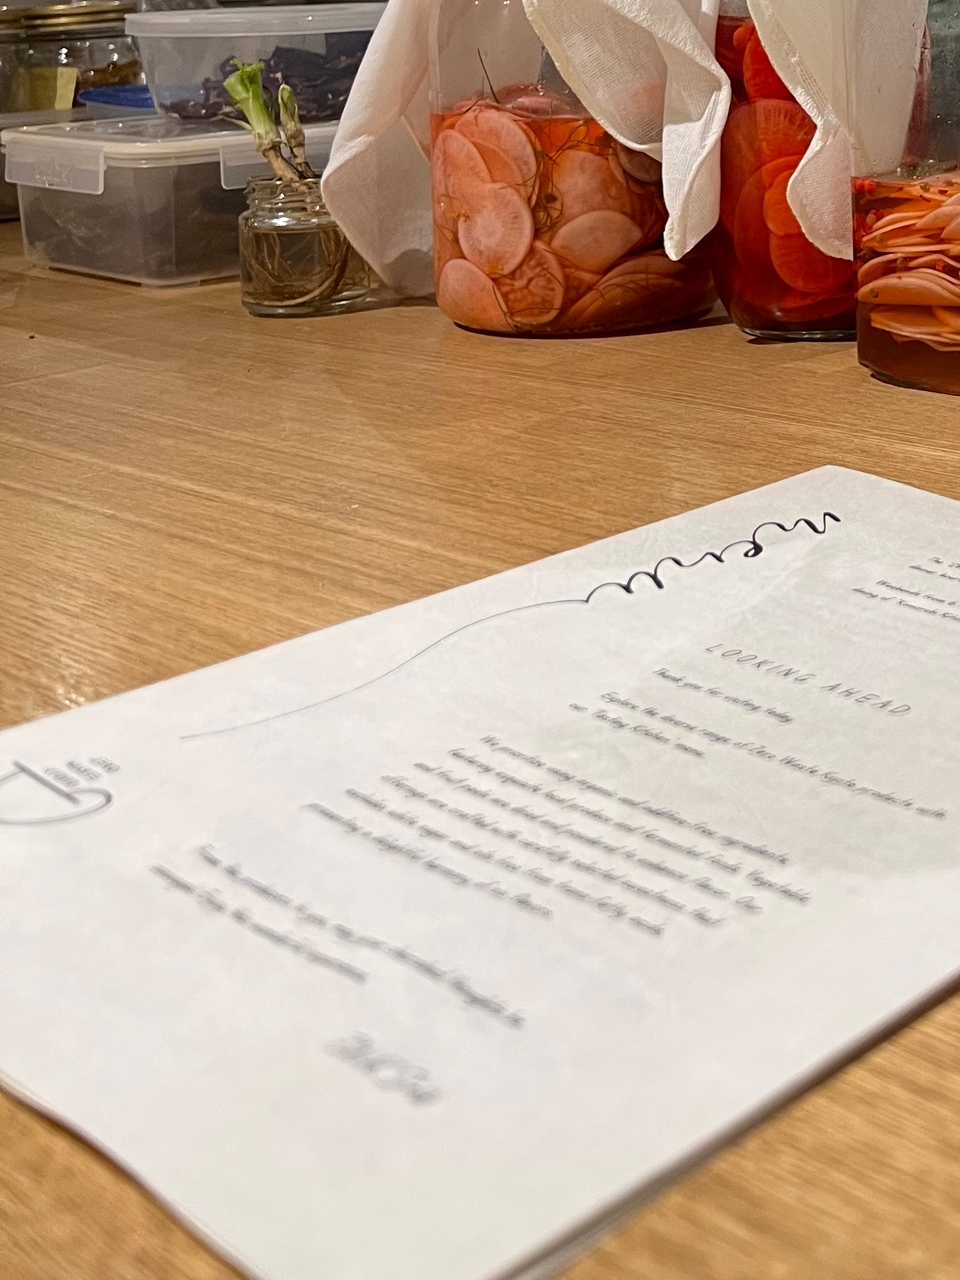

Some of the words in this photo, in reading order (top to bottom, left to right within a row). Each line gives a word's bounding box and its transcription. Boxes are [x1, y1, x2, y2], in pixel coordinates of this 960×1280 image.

[651, 667, 690, 683] Thank
[723, 695, 762, 711] visiting
[705, 643, 816, 682] LOOKING
[821, 683, 911, 714] AHEAD
[600, 691, 639, 711] Explore
[659, 715, 697, 731] diverse
[698, 728, 731, 743] range
[747, 744, 776, 759] Zero
[779, 756, 818, 775] Waste
[819, 771, 856, 788] Kyoto
[852, 786, 913, 807] products
[915, 807, 945, 819] with
